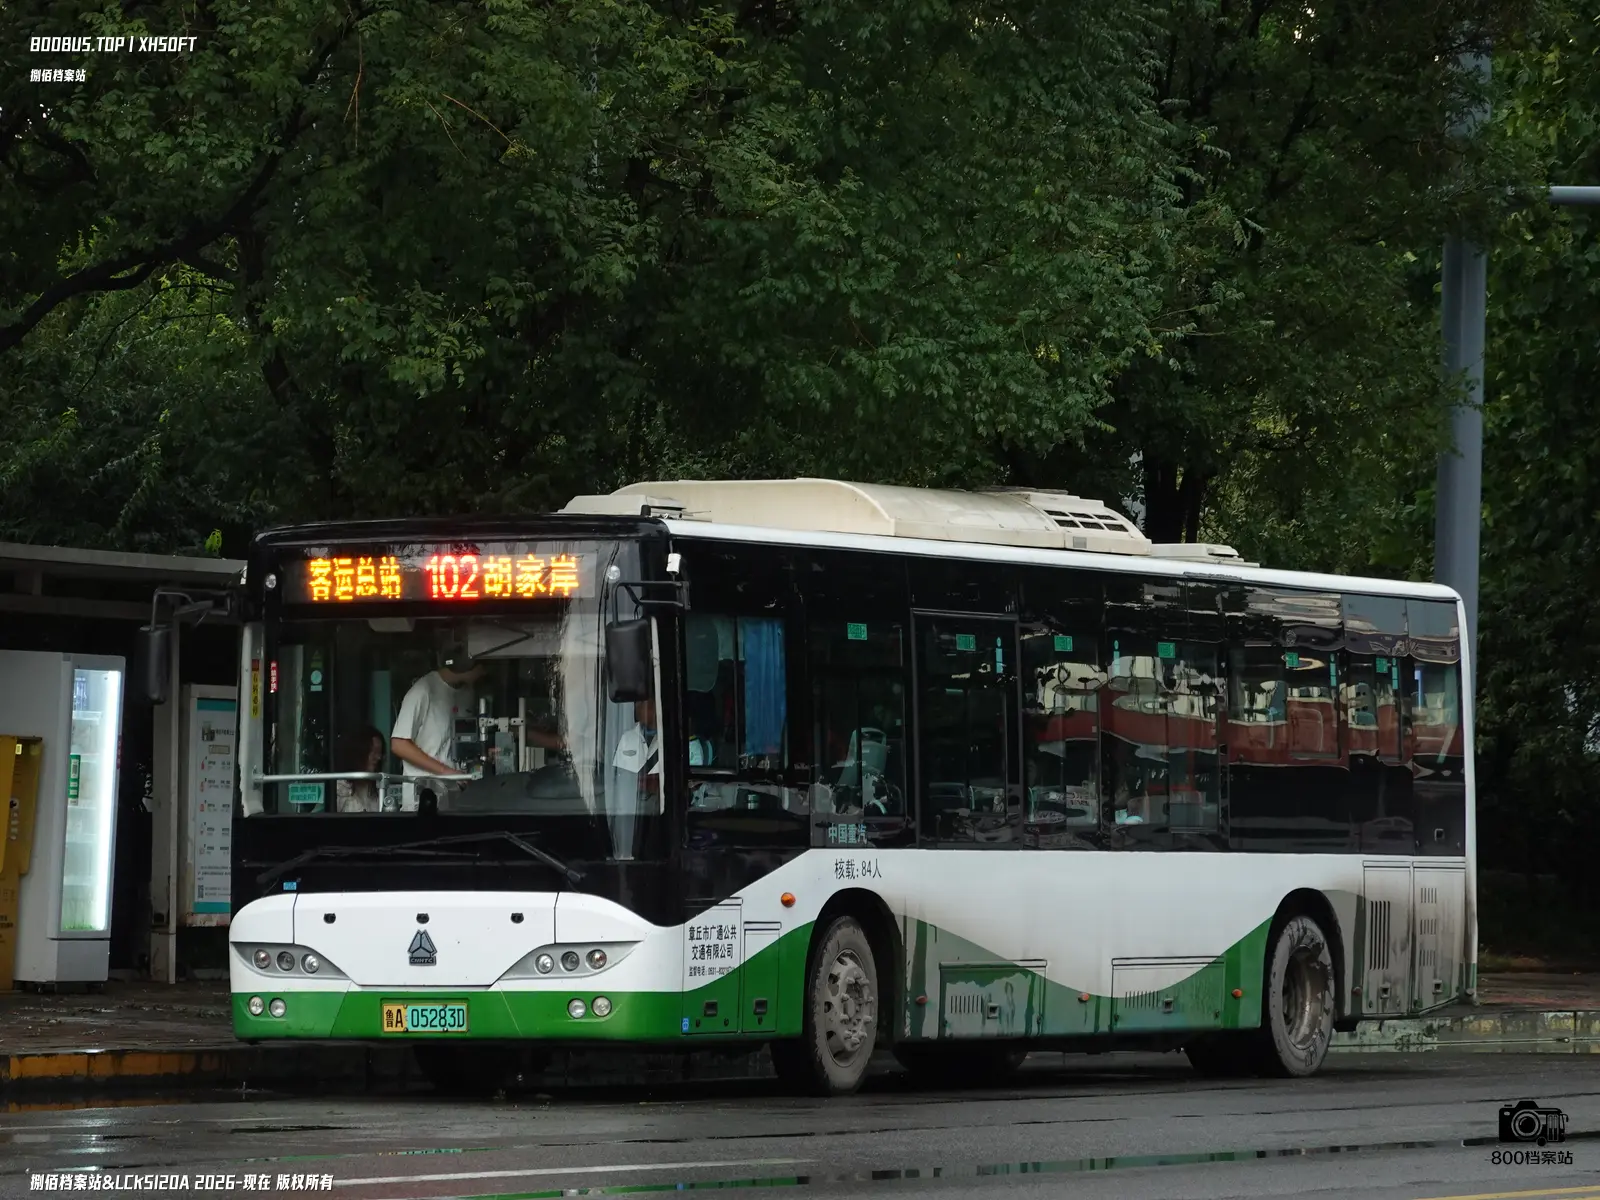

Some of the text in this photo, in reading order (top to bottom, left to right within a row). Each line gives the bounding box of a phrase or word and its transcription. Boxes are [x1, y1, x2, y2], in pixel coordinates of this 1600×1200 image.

[308, 554, 579, 600] 客运总站 102 胡家岸
[828, 822, 867, 844] 中国重汽
[688, 924, 737, 941] 章丘市广通公共
[691, 943, 733, 960] 交通有限公司
[410, 1008, 465, 1028] 05283D
